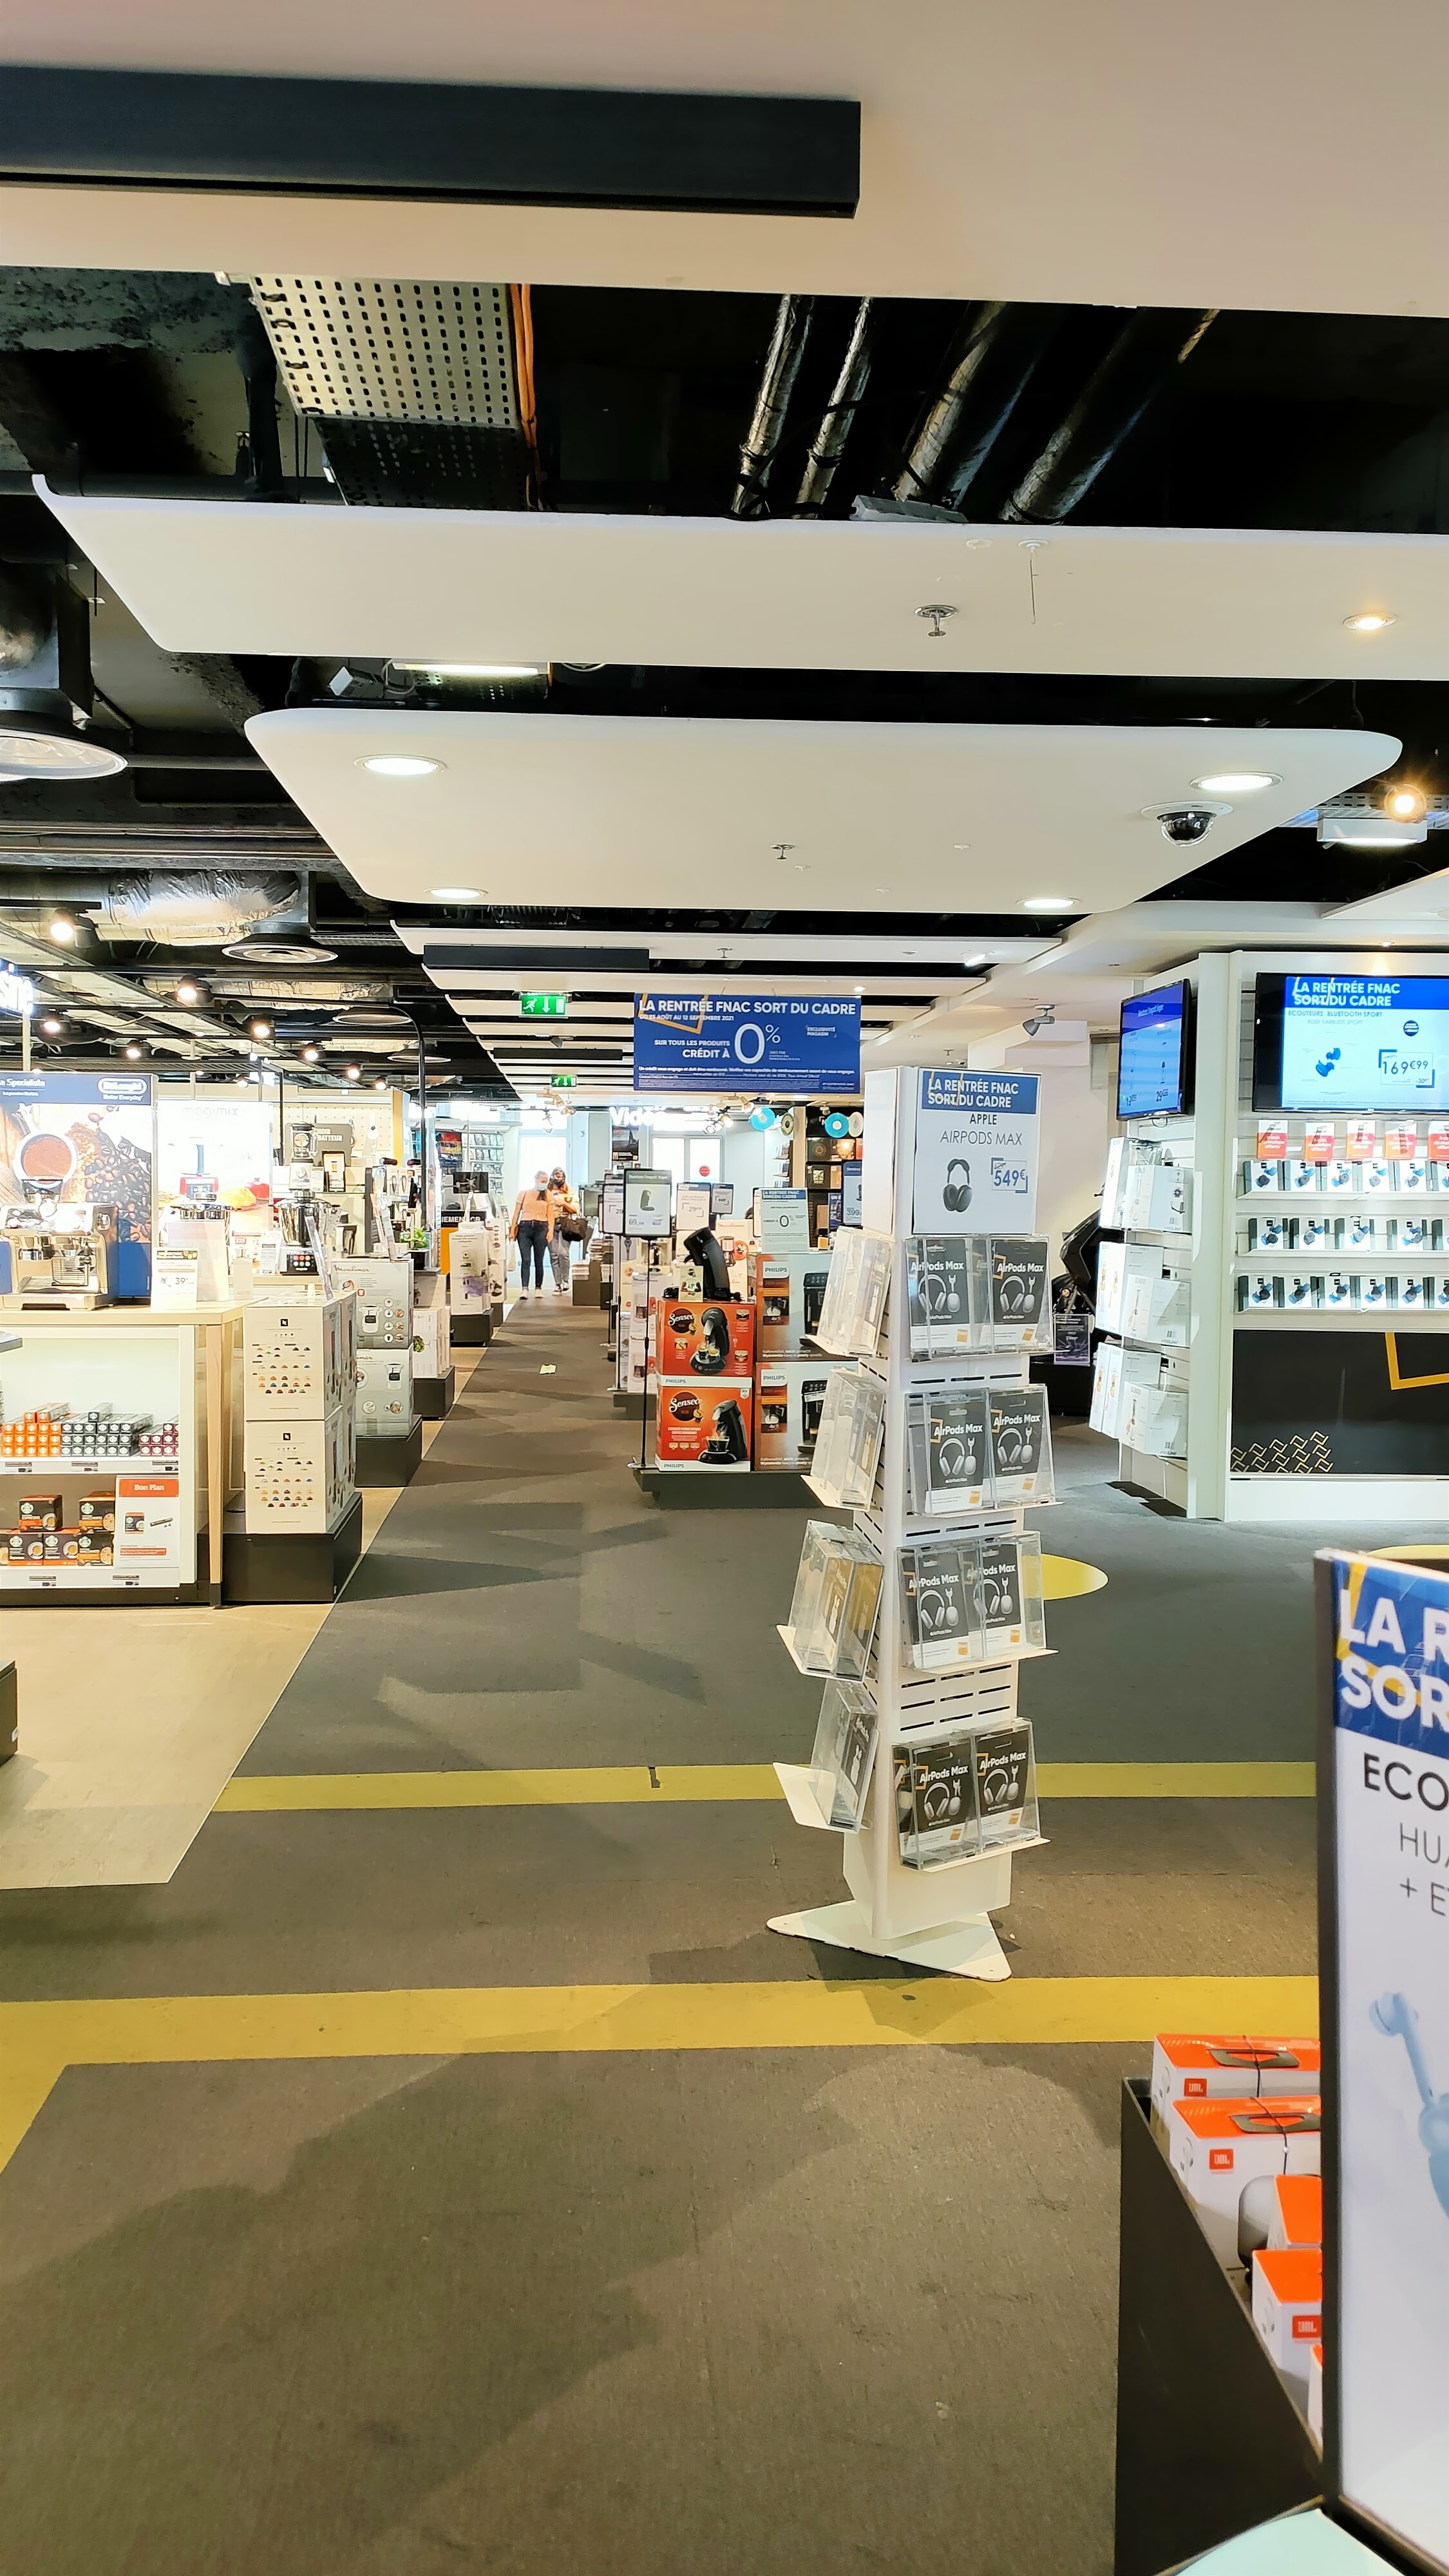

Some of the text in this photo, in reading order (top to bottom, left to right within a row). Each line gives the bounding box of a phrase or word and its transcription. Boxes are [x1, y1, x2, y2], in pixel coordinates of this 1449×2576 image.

[1294, 980, 1401, 994] LA RENTRÉE FNAC
[639, 998, 856, 1015] LA RENTRÉE FNAC SORT DU CADRE
[1294, 994, 1392, 1006] SORT DU CADRE
[683, 1048, 730, 1058] CRÉDIT À
[928, 1078, 1019, 1095] LA RENTRÉE FNAC
[927, 1094, 1012, 1108] SORT DU CADRE
[969, 1113, 998, 1125] APPLE
[940, 1130, 1023, 1146] AIRPODS MAX
[993, 1169, 1025, 1187] 549€
[911, 1260, 964, 1271] AirPods Max
[997, 1262, 1045, 1273] AirPods Max
[668, 1313, 696, 1326] Senseo
[668, 1397, 703, 1412] Senseo
[994, 1414, 1041, 1426] AirPods Max
[934, 1423, 983, 1437] AirPods Max
[999, 1563, 1016, 1573] Max
[909, 1573, 960, 1589] AirPods Max
[1339, 1588, 1406, 1655] LA
[1340, 1656, 1449, 1733] SOR
[980, 1752, 1027, 1770] AirPods Max
[920, 1765, 969, 1783] AirPods Max
[1363, 1752, 1449, 1811] ECO
[1399, 1821, 1449, 1868] HU
[1430, 1882, 1449, 1917] E
[1188, 2083, 1204, 2092] JBL
[1214, 2154, 1230, 2164] JBL
[1298, 2320, 1318, 2333] JBL
